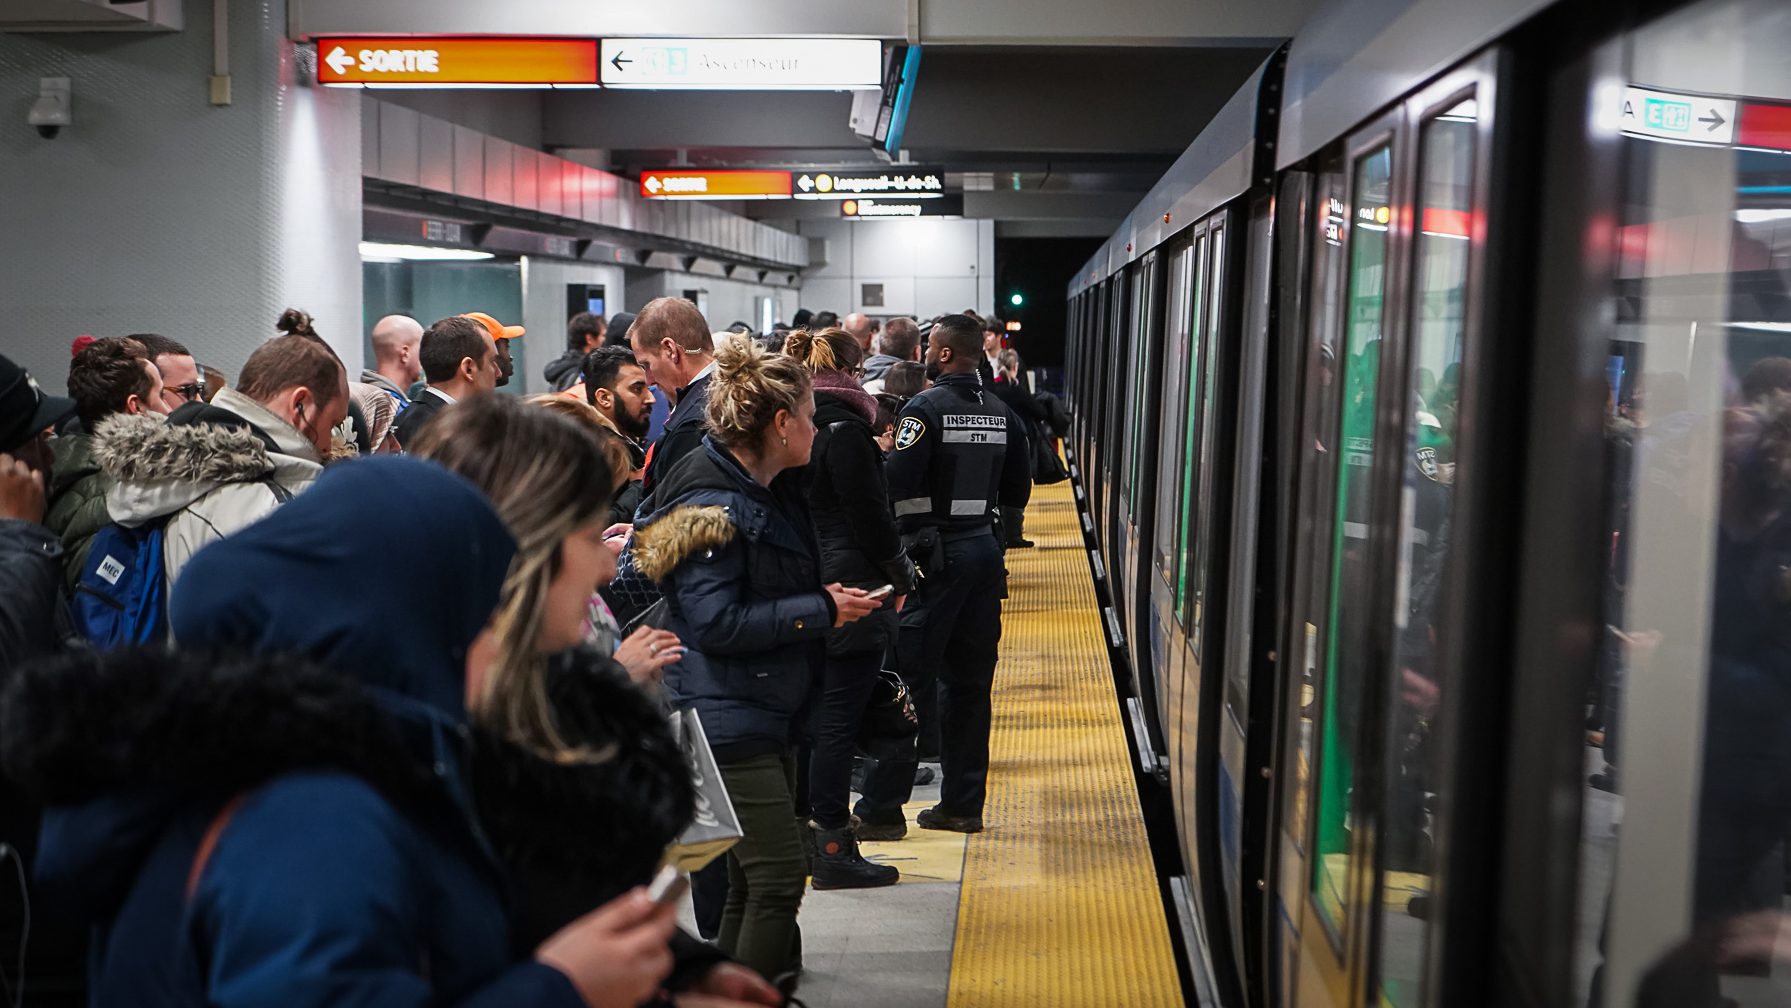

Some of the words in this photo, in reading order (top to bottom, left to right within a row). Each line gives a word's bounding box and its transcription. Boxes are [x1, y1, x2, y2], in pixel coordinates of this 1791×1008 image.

[359, 50, 440, 73] SORTIE
[902, 419, 922, 432] STM
[947, 415, 1006, 427] INSPECTEUR
[970, 433, 987, 442] STM
[102, 561, 120, 578] MEC
